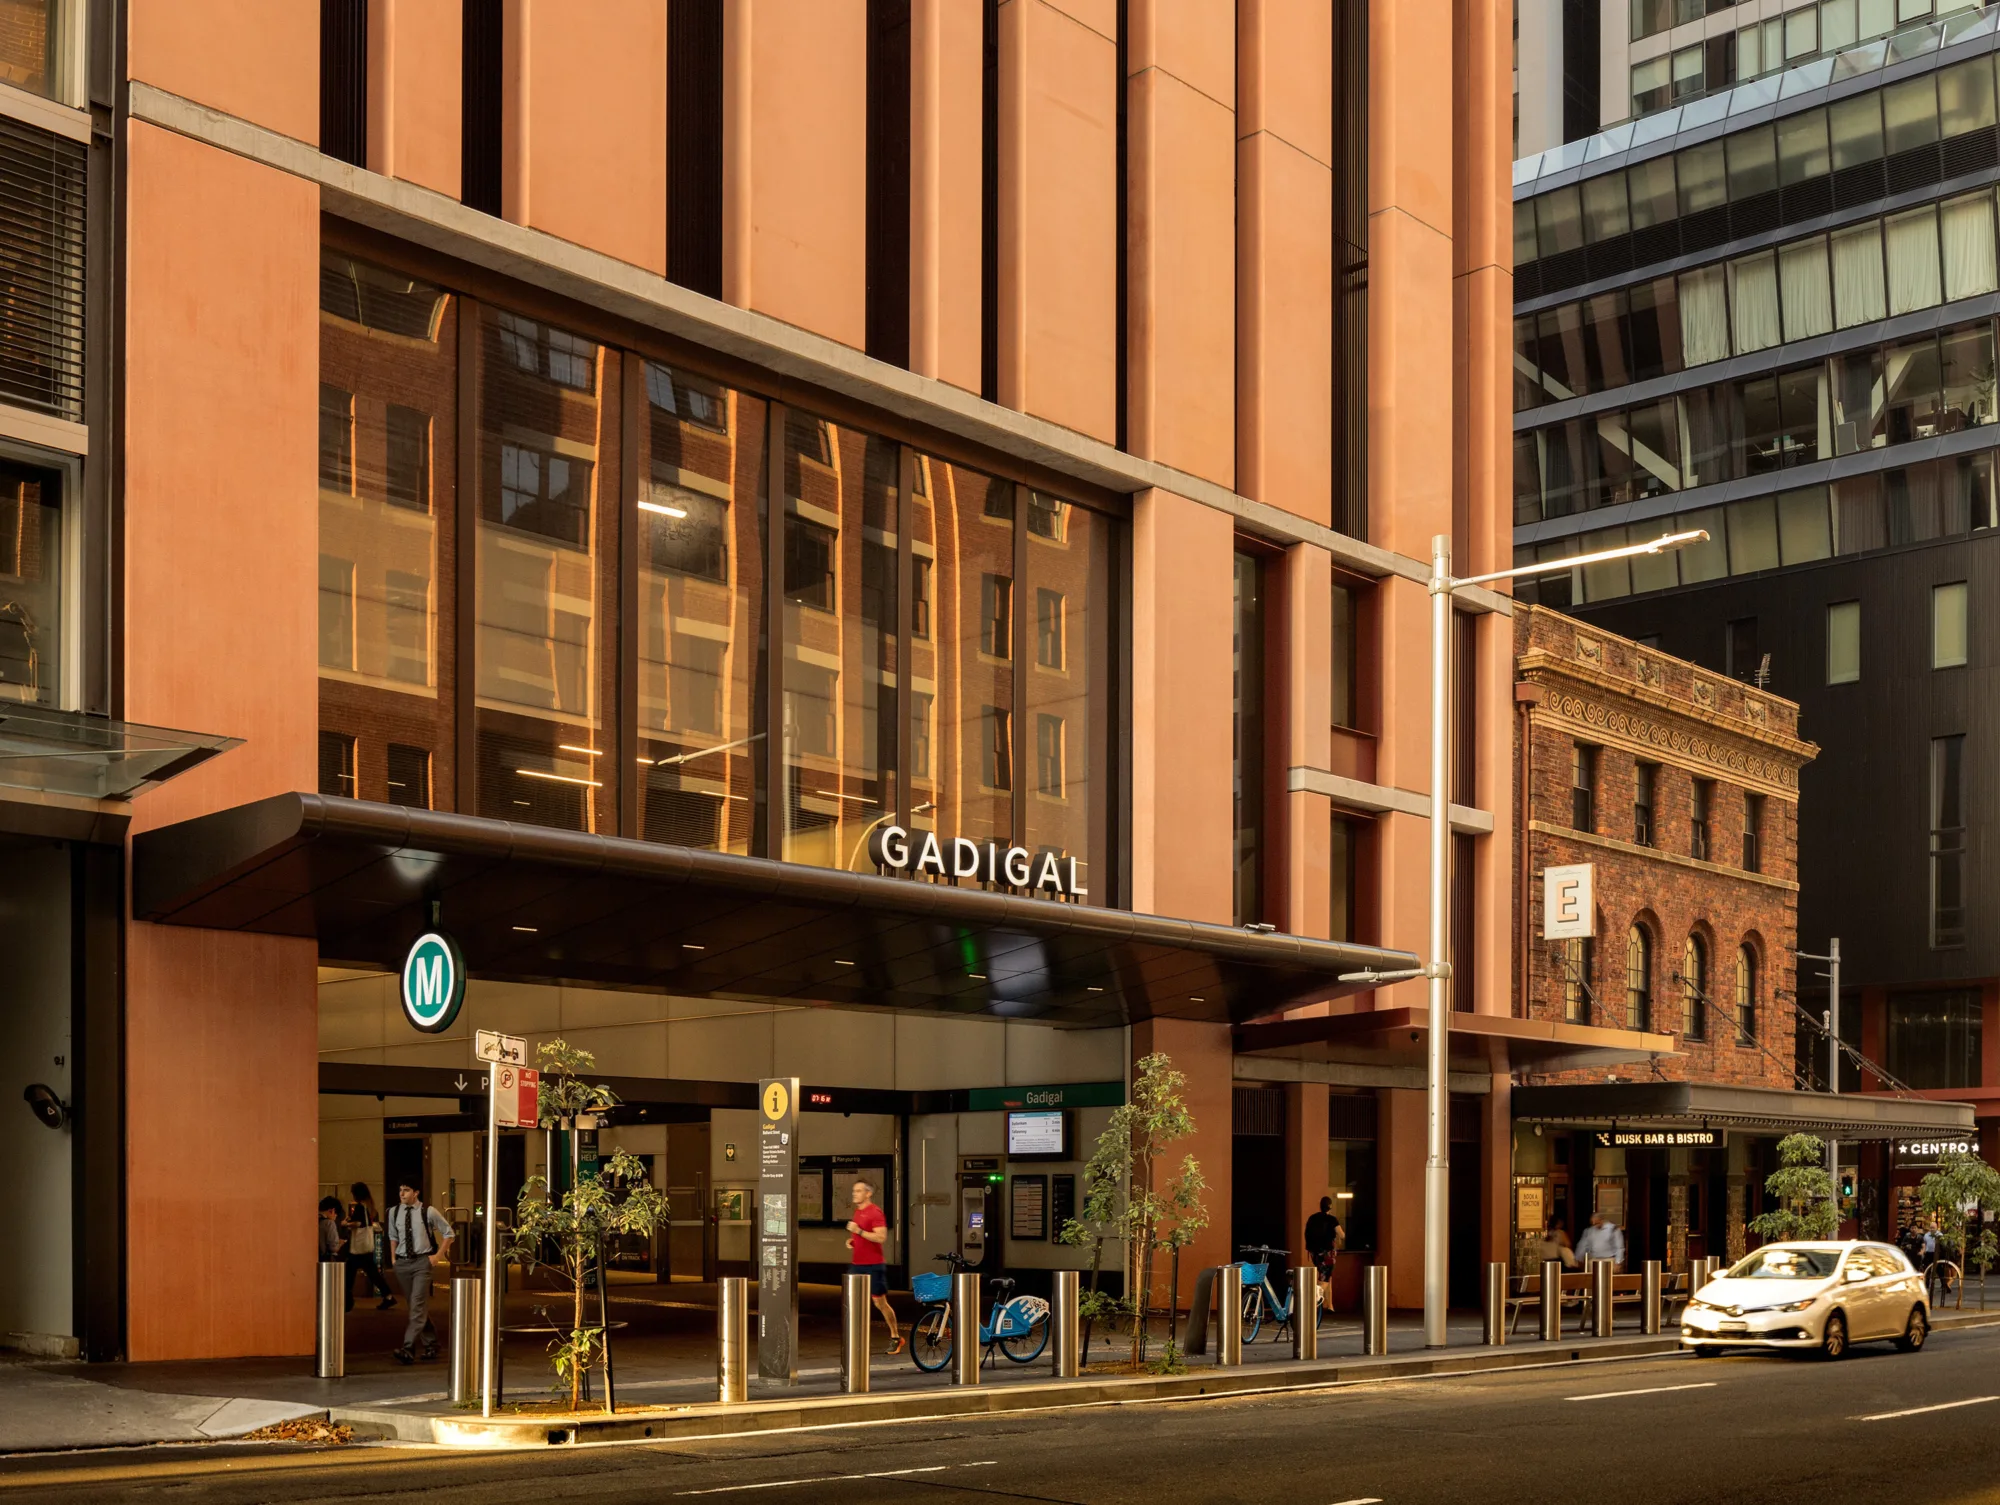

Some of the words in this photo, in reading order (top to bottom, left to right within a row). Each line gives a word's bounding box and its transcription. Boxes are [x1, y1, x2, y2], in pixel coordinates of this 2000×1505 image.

[881, 826, 1088, 895] GADIGAL
[1557, 880, 1579, 923] E
[415, 955, 442, 1006] M
[520, 1080, 537, 1089] STOPPING
[1026, 1090, 1063, 1106] Gadigal
[1615, 1134, 1642, 1144] DUSK
[1644, 1134, 1665, 1144] BAR
[1666, 1134, 1675, 1144] &
[1676, 1133, 1714, 1143] BISTRO
[1910, 1142, 1969, 1154] CENTRO
